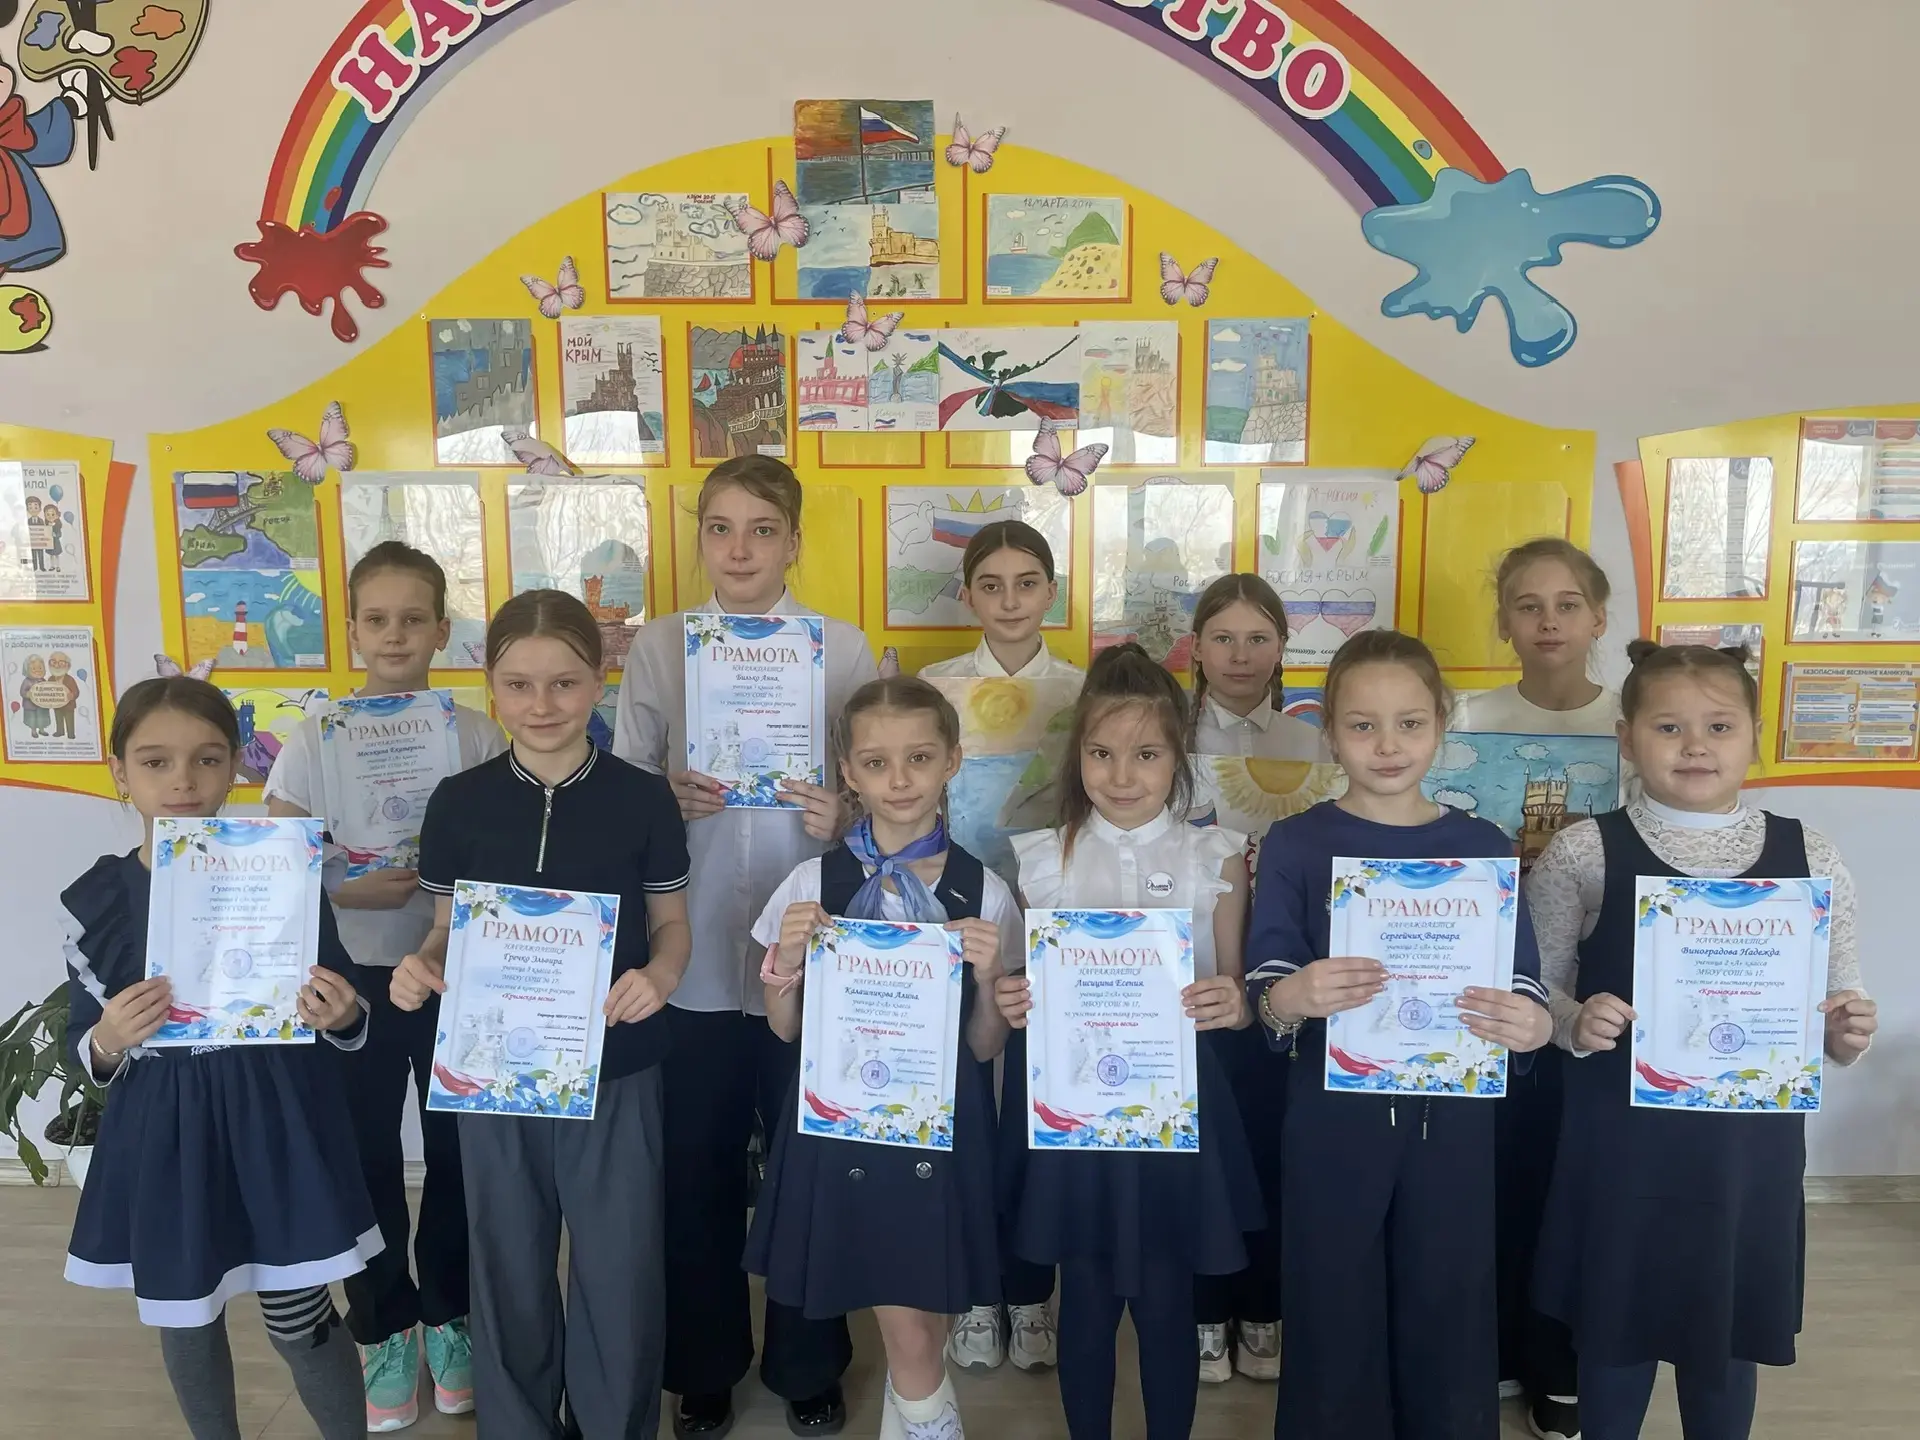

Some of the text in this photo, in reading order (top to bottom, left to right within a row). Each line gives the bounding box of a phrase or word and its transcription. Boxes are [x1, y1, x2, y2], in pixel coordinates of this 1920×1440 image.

[332, 0, 520, 122] НА
[1113, 0, 1351, 119] ТВО
[567, 333, 592, 347] МОЙ
[566, 348, 601, 364] КРЫМ
[24, 479, 48, 490] ила!
[1326, 569, 1370, 582] КРЫМ
[712, 646, 800, 663] ГРАМОТА
[348, 719, 435, 742] ГРАМОТА
[189, 855, 292, 872] ГРАМОТА
[1367, 897, 1482, 917] ГРАМОТА
[482, 920, 585, 947] ГРАМОТА
[1674, 917, 1796, 936] ГРАМОТА
[1424, 932, 1462, 941] Варвара
[504, 953, 530, 963] Гречко
[1060, 948, 1164, 966] ГРАМОТА
[1681, 947, 1738, 957] Виноградова
[837, 954, 934, 980] ГРАМОТА
